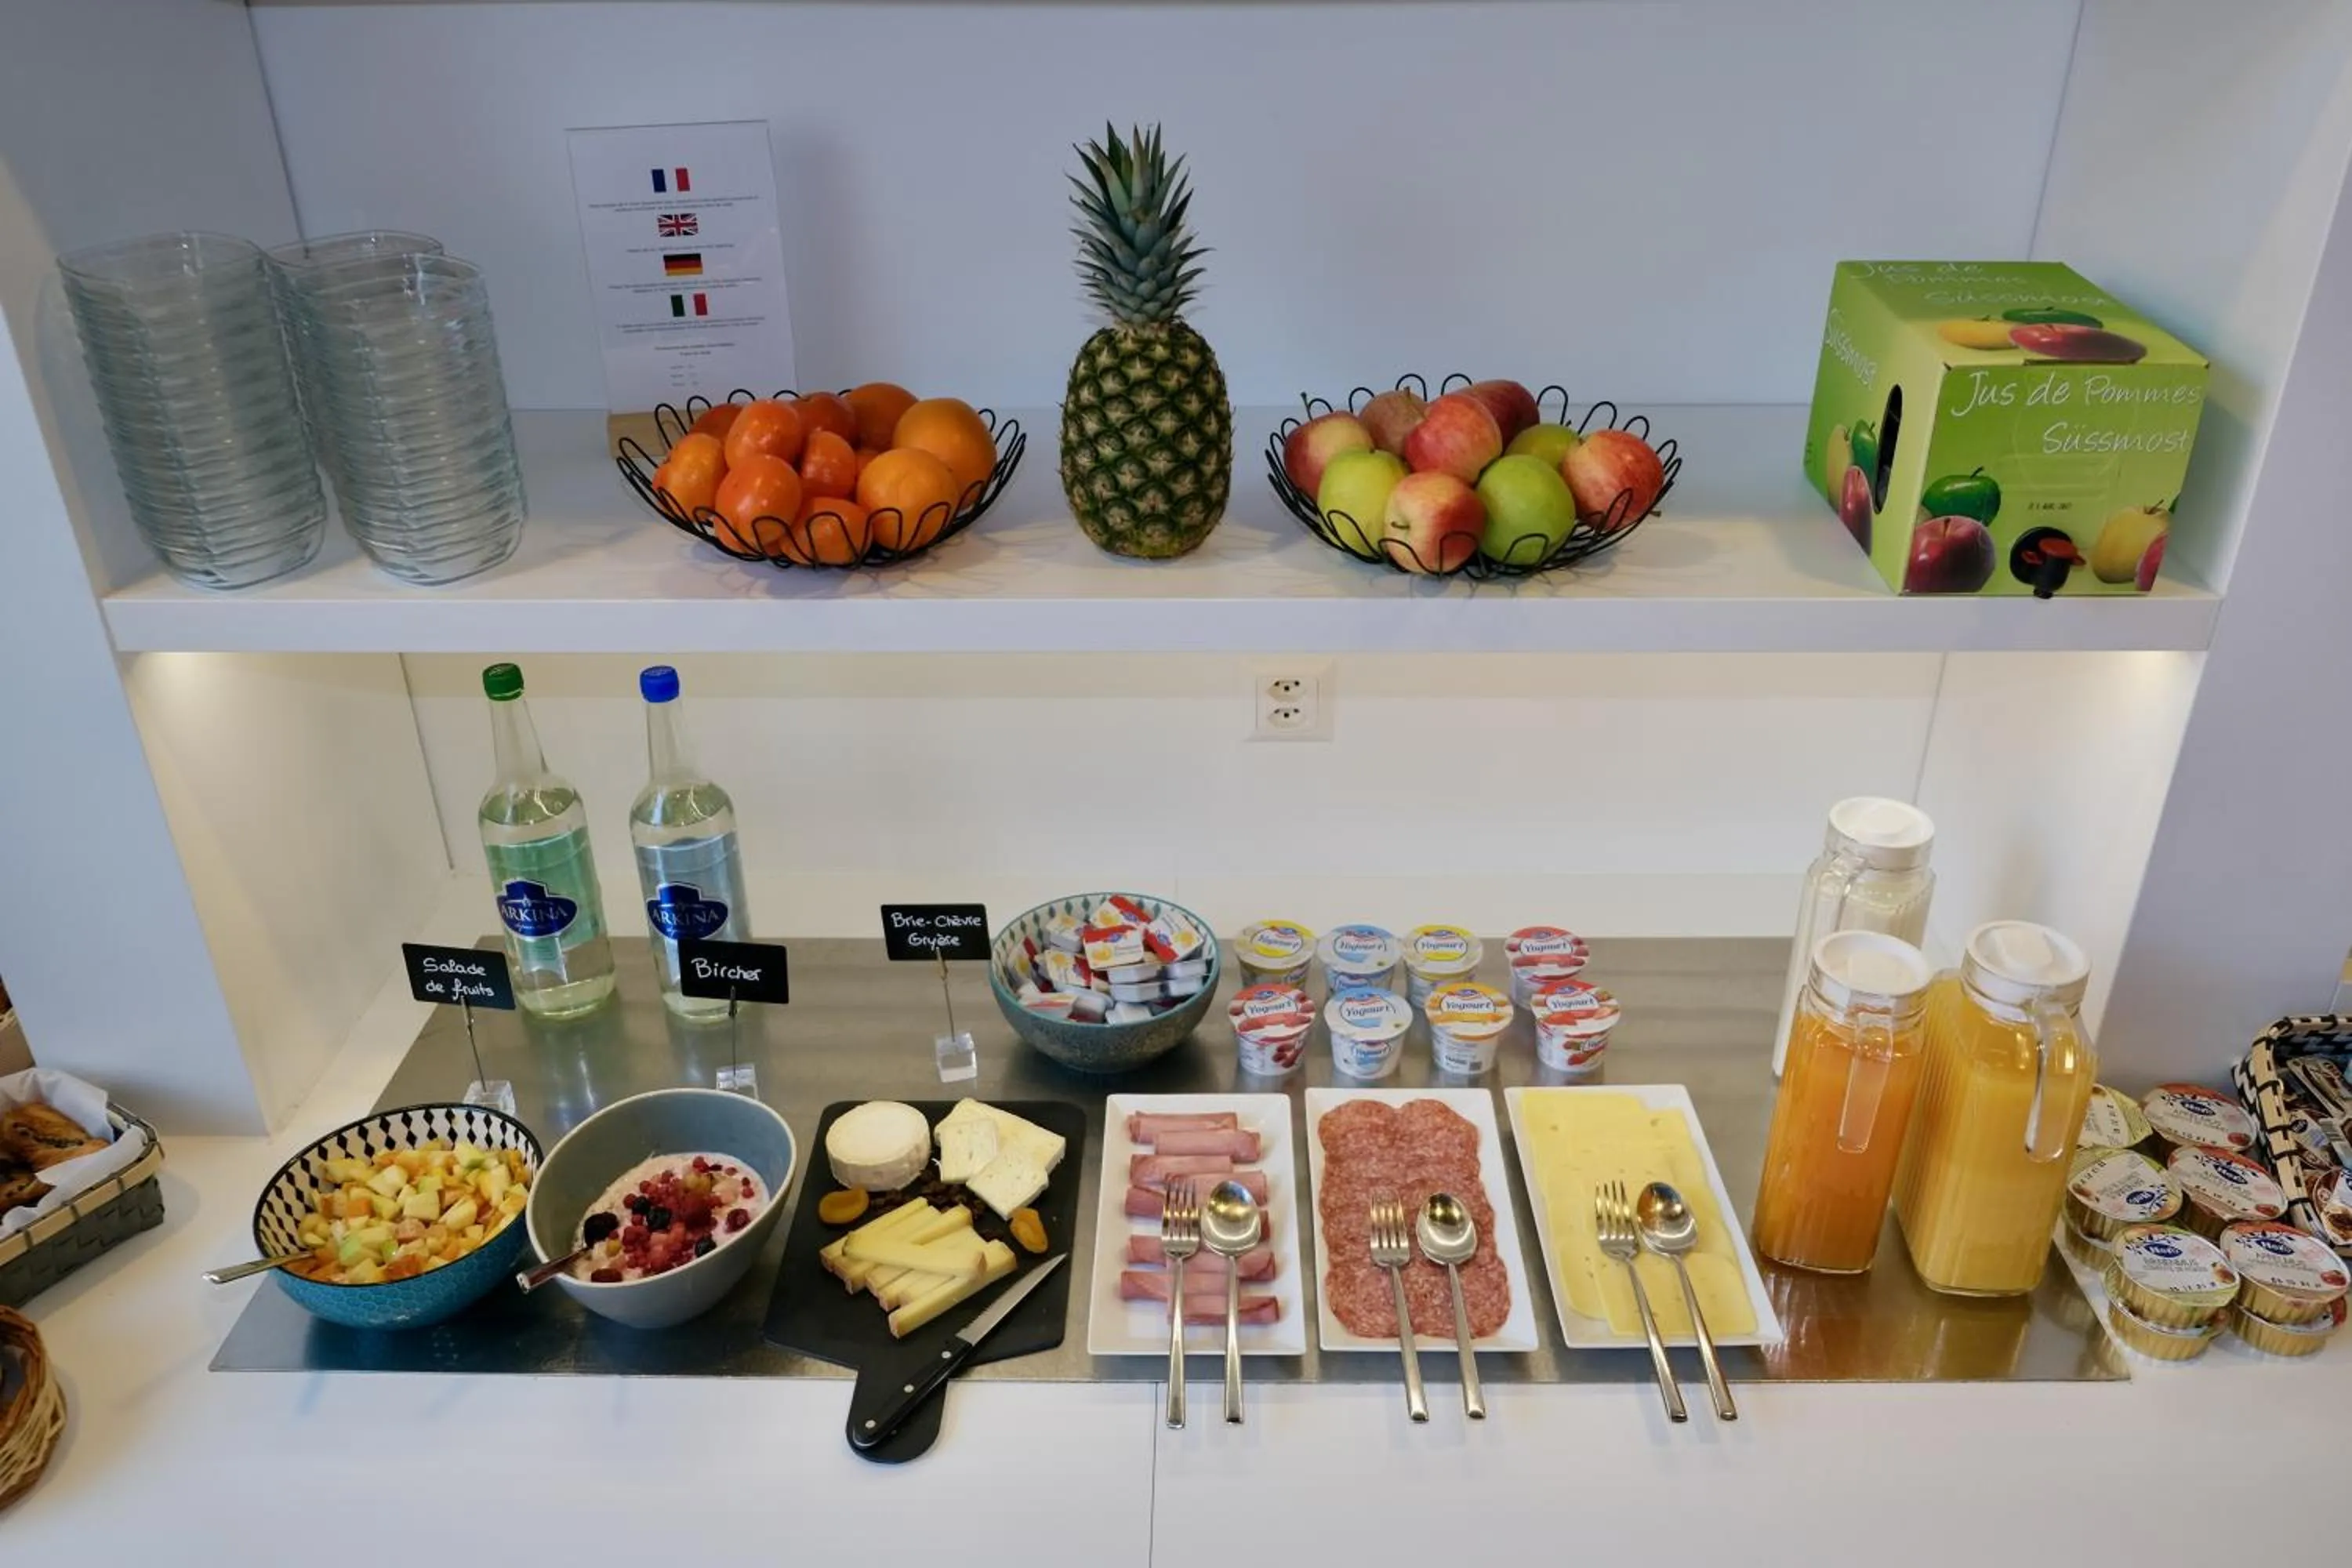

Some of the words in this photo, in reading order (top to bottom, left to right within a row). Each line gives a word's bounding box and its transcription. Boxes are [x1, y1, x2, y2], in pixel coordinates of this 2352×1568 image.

[1951, 371, 2017, 416] Jus
[2027, 372, 2071, 406] de
[2084, 375, 2201, 406] Pommes
[2043, 422, 2190, 454] Süssmost
[501, 903, 568, 923] ARKINA
[652, 909, 720, 925] ARKINA
[423, 957, 487, 976] Salade
[691, 957, 762, 981] Bircher
[426, 980, 445, 993] de
[452, 978, 495, 1000] fruits
[1345, 1005, 1389, 1017] Yogourt
